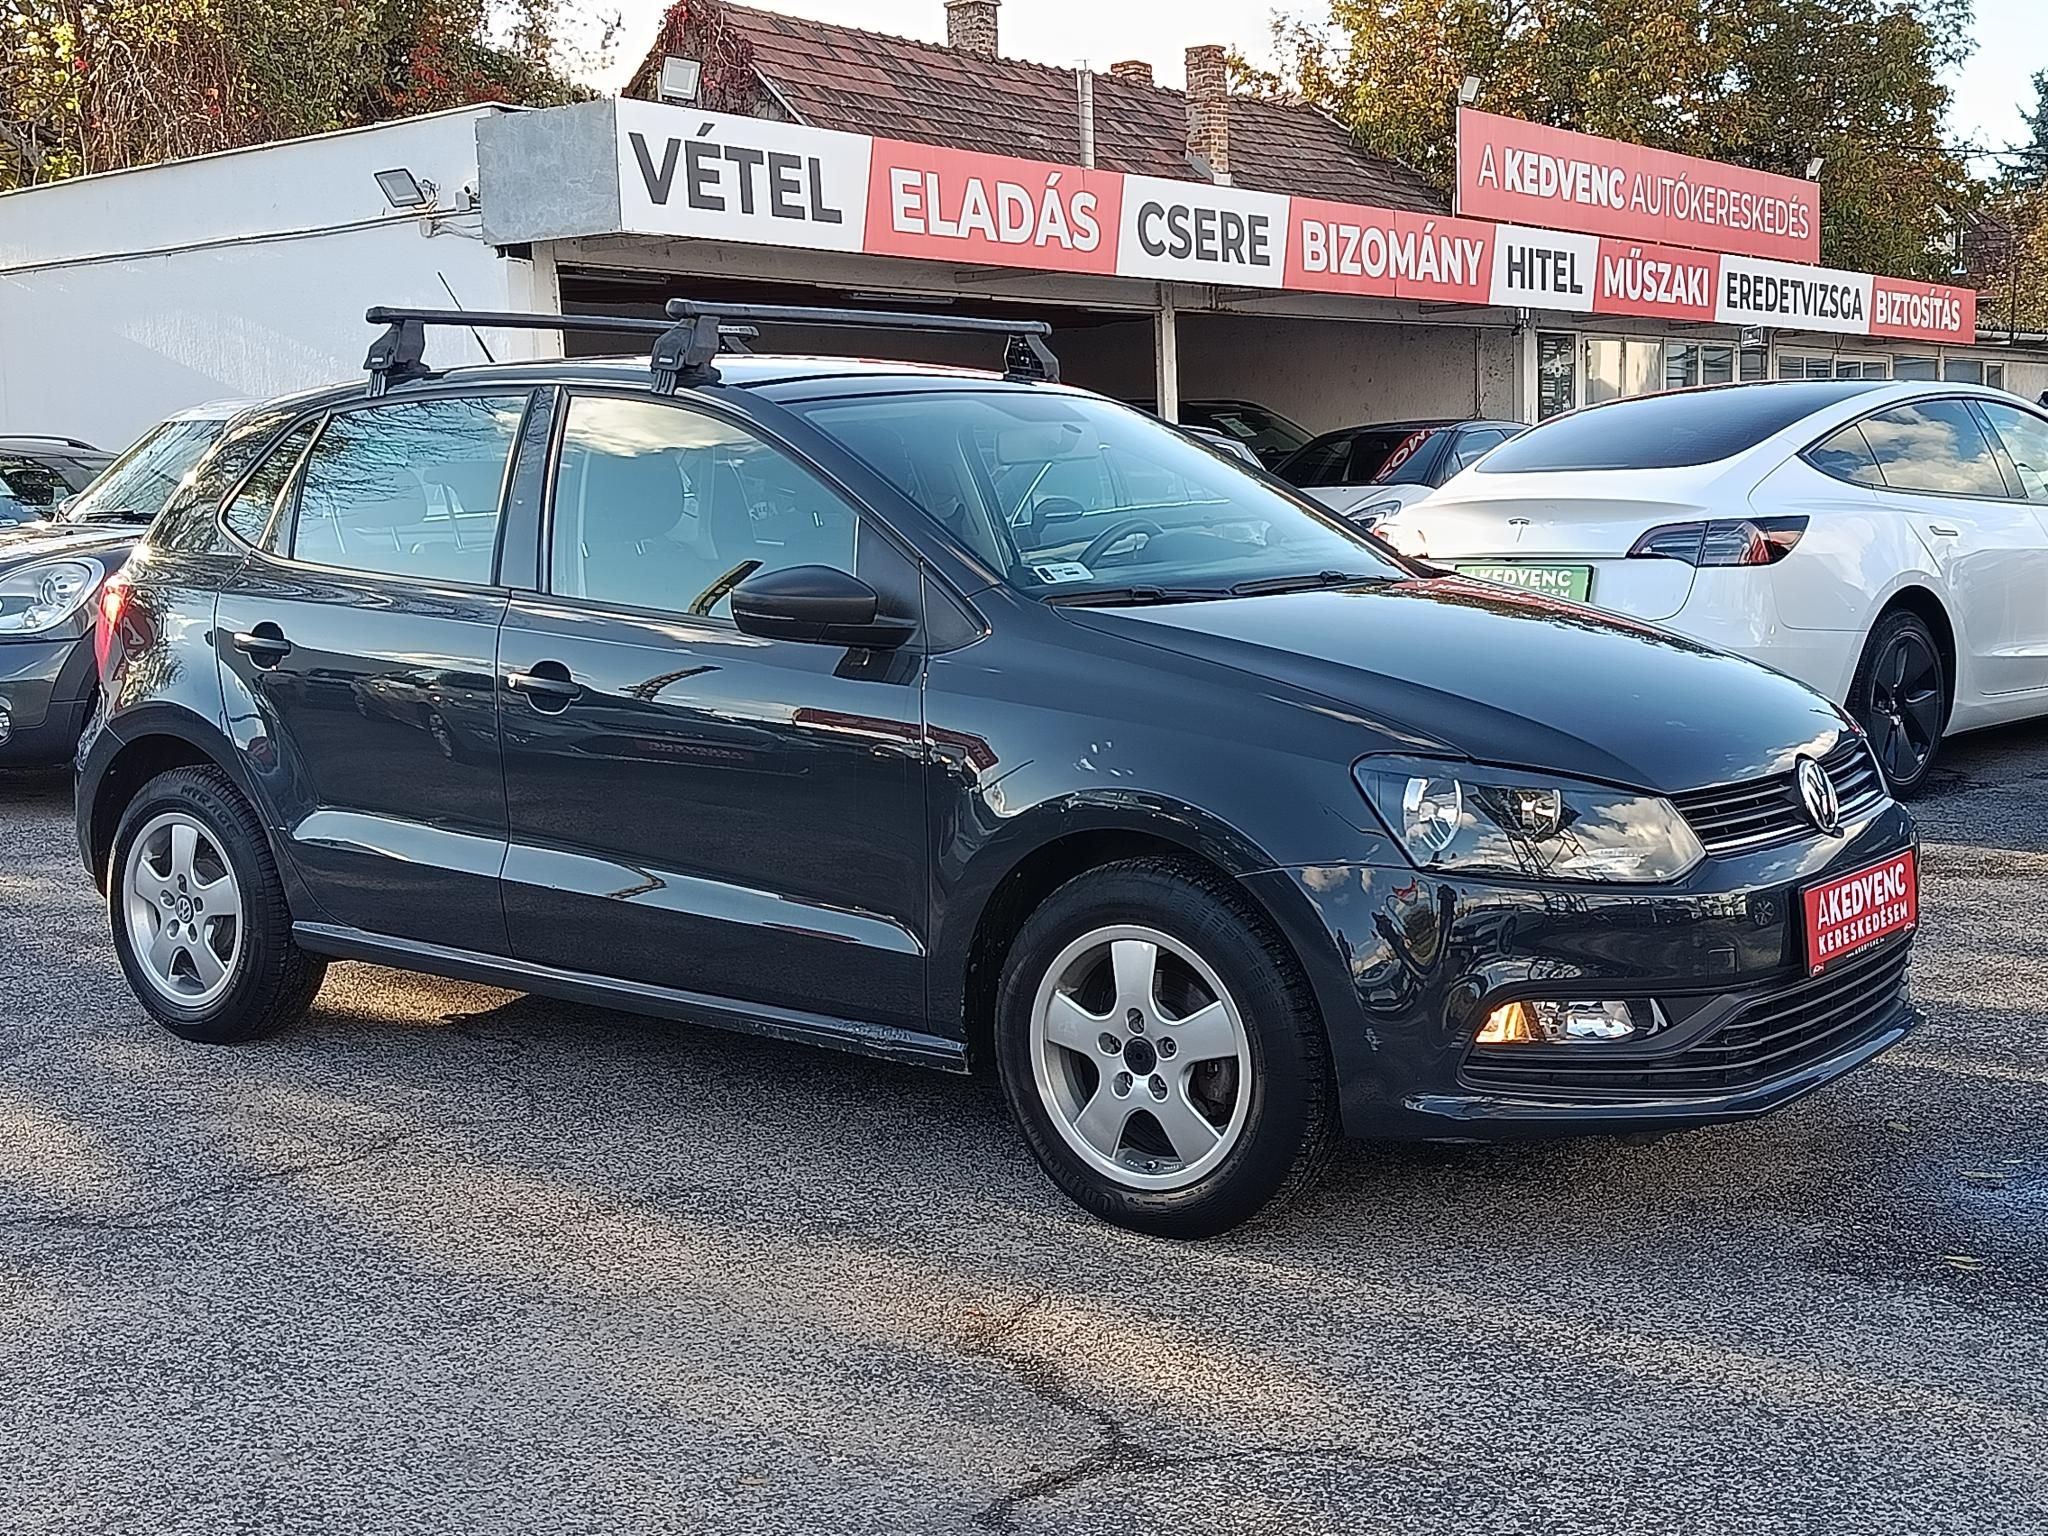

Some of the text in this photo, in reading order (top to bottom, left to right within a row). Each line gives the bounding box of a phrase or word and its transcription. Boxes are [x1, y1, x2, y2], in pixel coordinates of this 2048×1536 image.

[627, 123, 1962, 333] VÉTEL ELADÁS CSERE BIZOMÁNY HITEL MŰSZAKI EREDETVIZSGA BIZTOSÍTÁS
[1478, 144, 1809, 240] A KEDVENC AUTÓKERESKEDÉS
[1818, 900, 1908, 956] KERESKEDÉSEM
